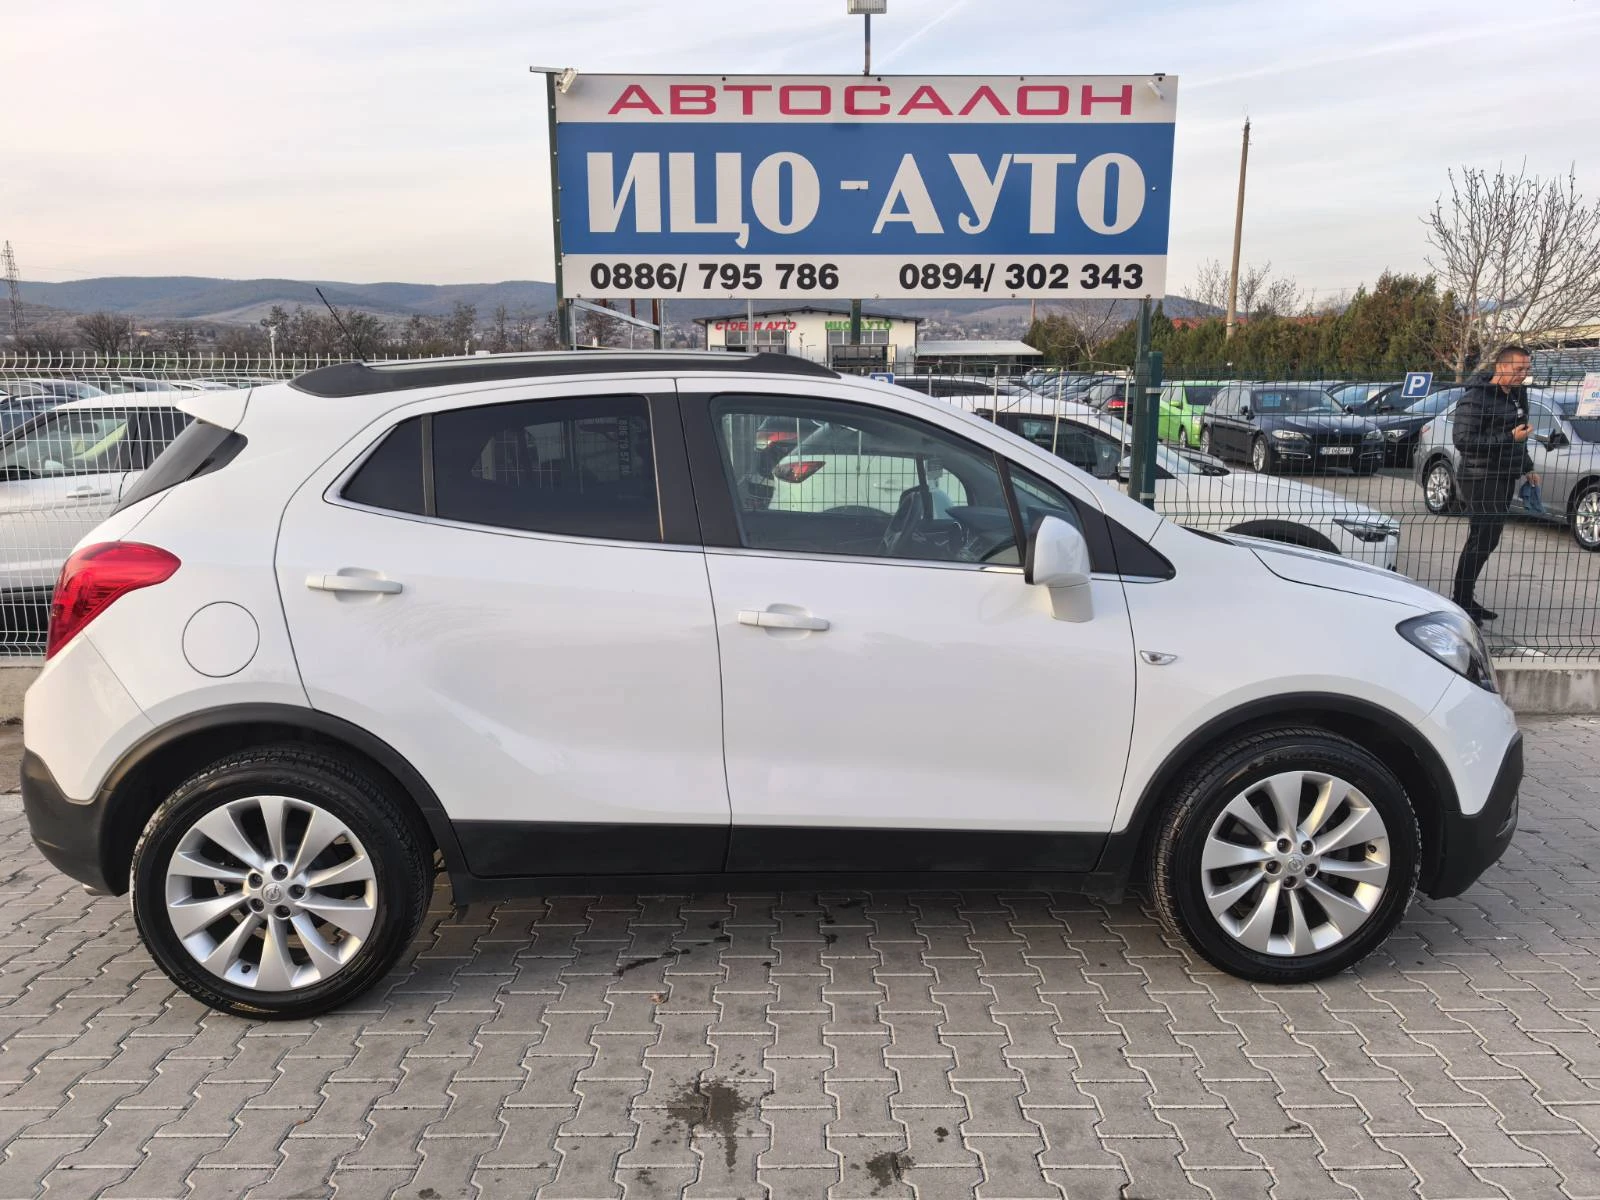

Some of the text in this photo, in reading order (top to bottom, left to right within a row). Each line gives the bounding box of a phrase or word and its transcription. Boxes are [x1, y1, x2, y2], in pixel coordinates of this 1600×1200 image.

[607, 84, 1134, 116] АВТОСАЛОН
[586, 151, 821, 249] ИЦО
[871, 152, 1147, 236] АУТО
[590, 263, 840, 293] 0886/ 795 786
[899, 263, 1144, 293] 0894/ 302 343
[1408, 376, 1426, 395] P
